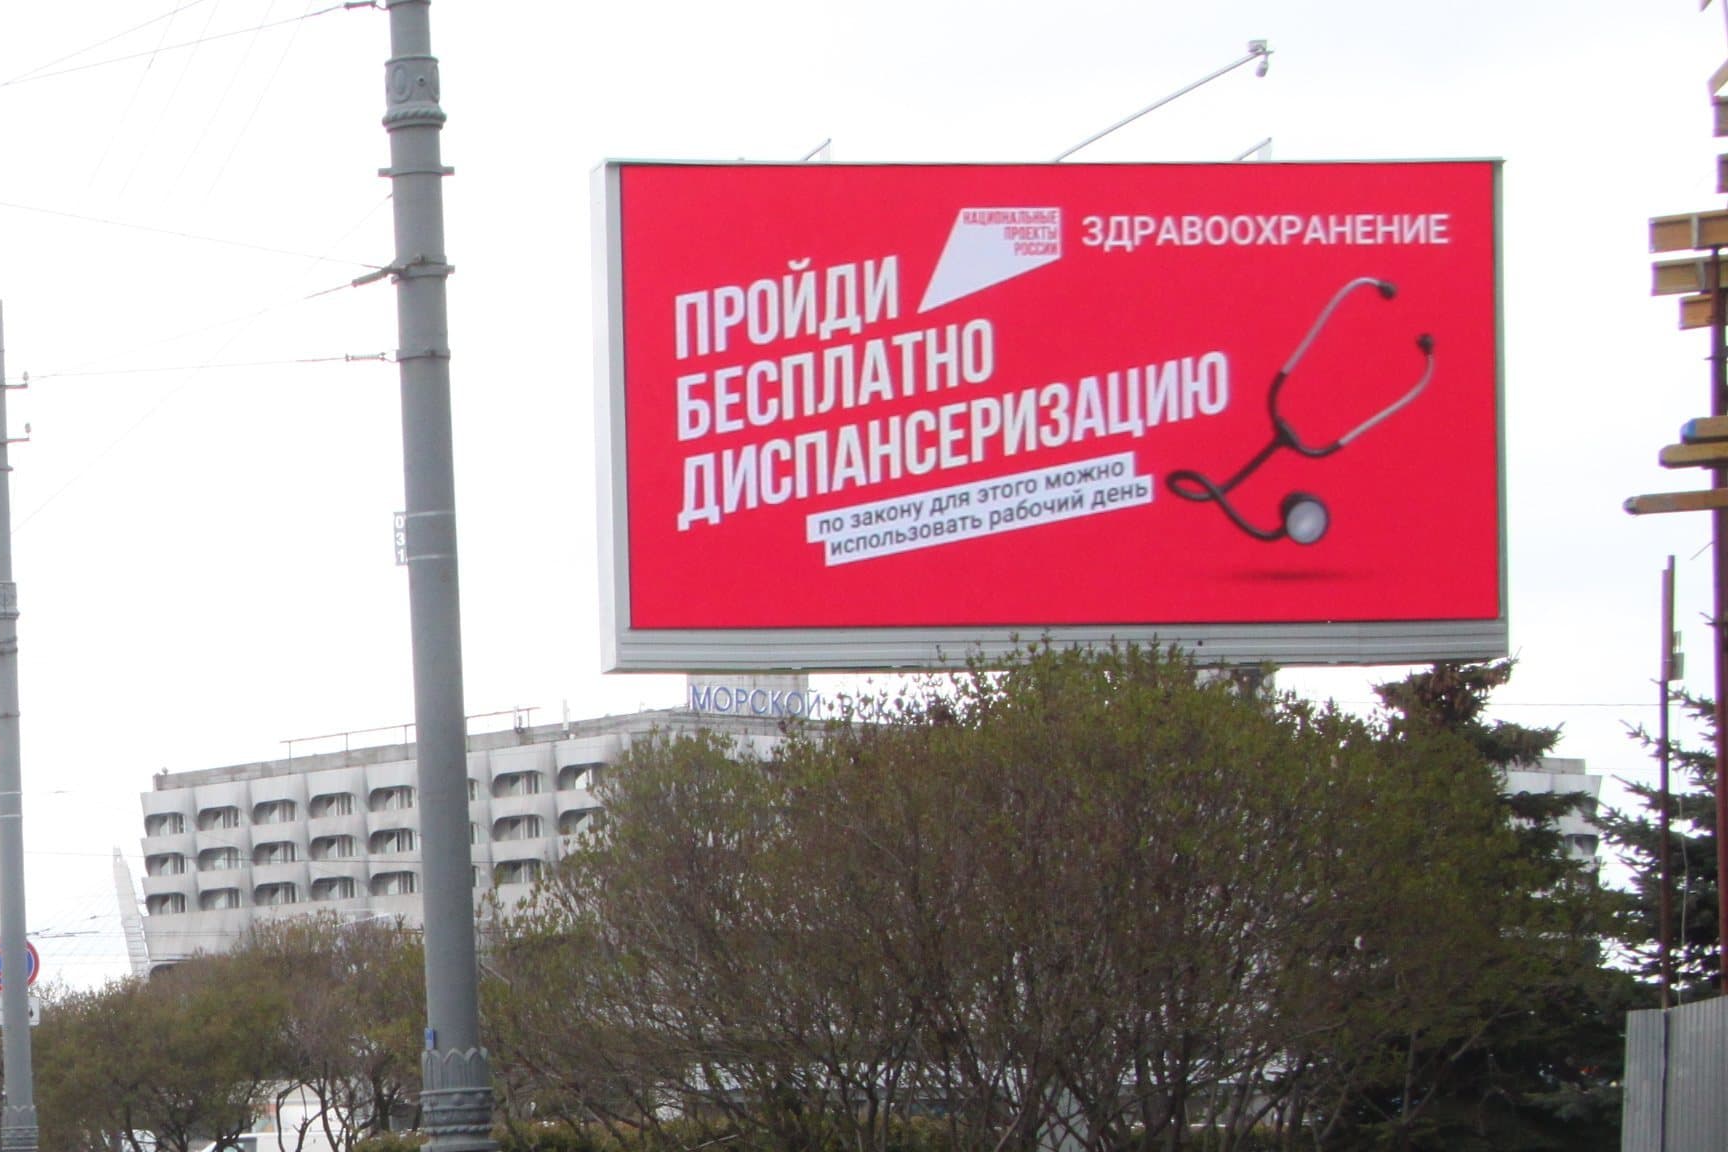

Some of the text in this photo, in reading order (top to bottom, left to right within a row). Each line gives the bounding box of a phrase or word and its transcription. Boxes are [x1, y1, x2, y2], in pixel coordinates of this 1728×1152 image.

[1004, 226, 1058, 240] ПРОЕКТЫ
[1013, 242, 1058, 256] РОССИИ
[1081, 214, 1450, 253] ЗДРАВООХРАНЕНИЕ
[675, 255, 899, 360] ПРОЙДИ
[676, 318, 994, 441] БЕСПЛАТНО
[677, 351, 1229, 531] ДИСПАНСЕРИЗАЦИЮ
[818, 459, 1125, 535] по закону для этого можно
[830, 481, 1148, 556] использовать рабочий день
[689, 684, 821, 720] МОРСКОЙ
